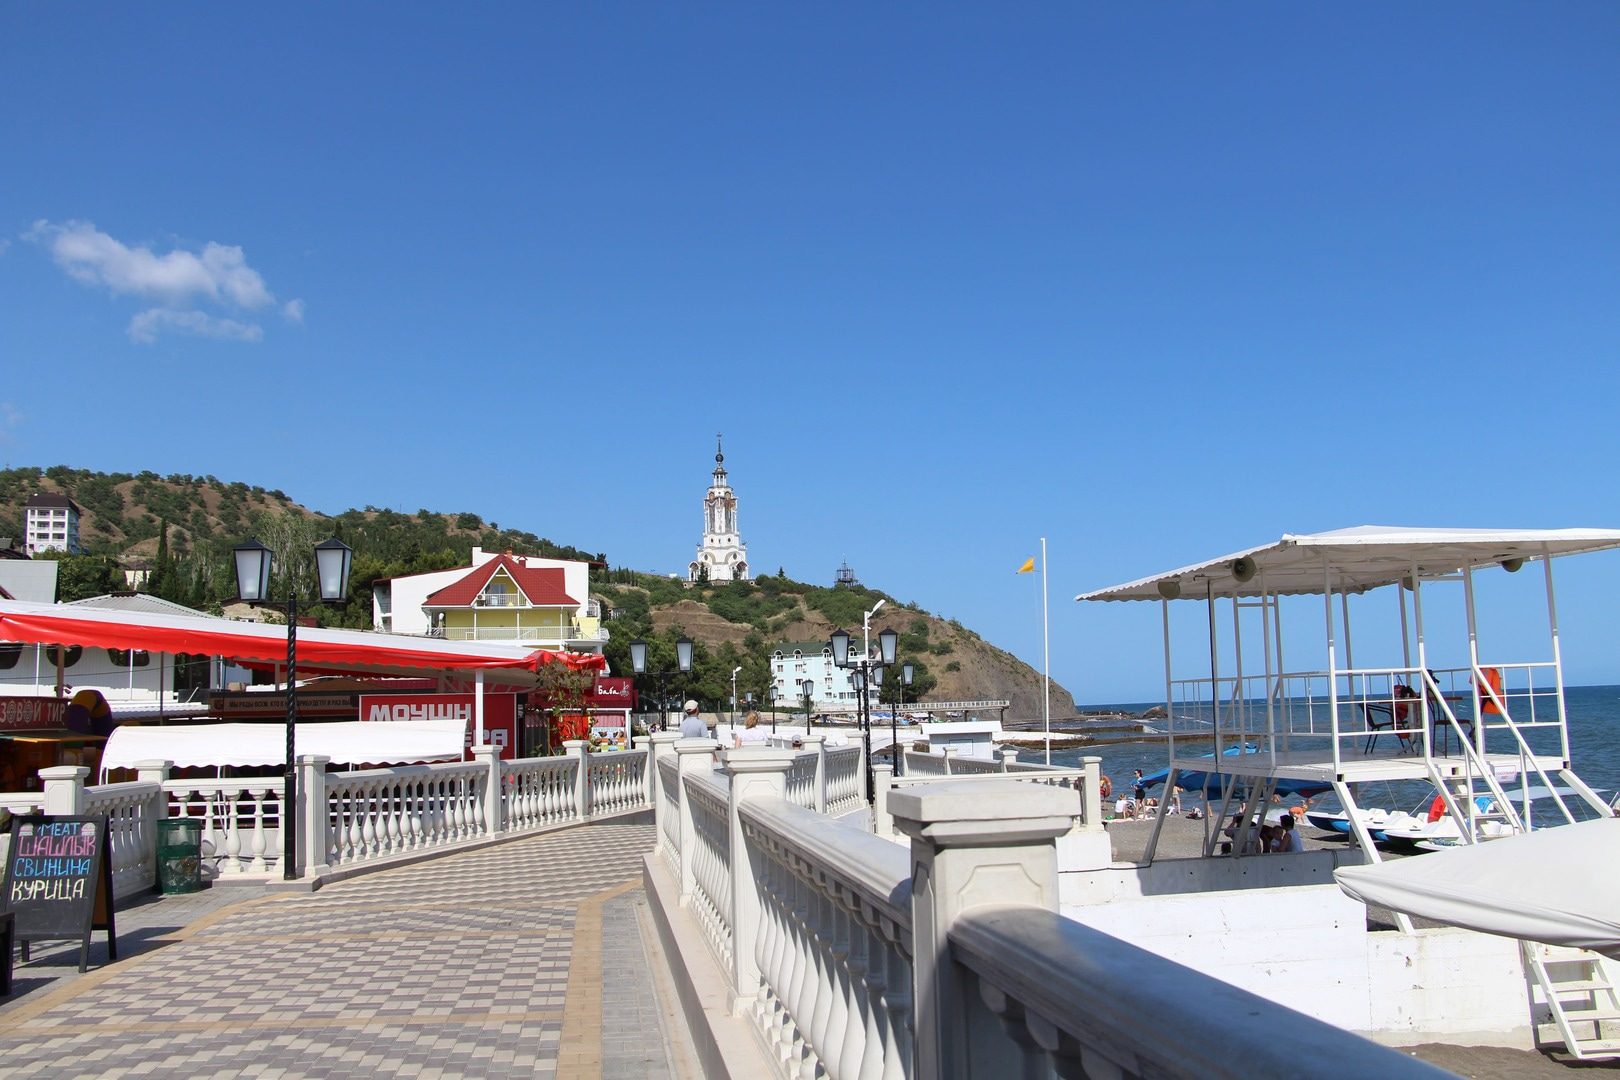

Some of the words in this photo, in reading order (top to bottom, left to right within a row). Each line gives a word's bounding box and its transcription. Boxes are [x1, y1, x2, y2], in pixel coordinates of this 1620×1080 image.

[47, 702, 66, 722] ТИР
[369, 703, 472, 721] МОУШН
[40, 822, 81, 837] MEAT
[19, 835, 96, 857] ШАШЛЫК
[15, 858, 91, 877] СВИНИНА
[11, 878, 85, 902] КУРИЦА
